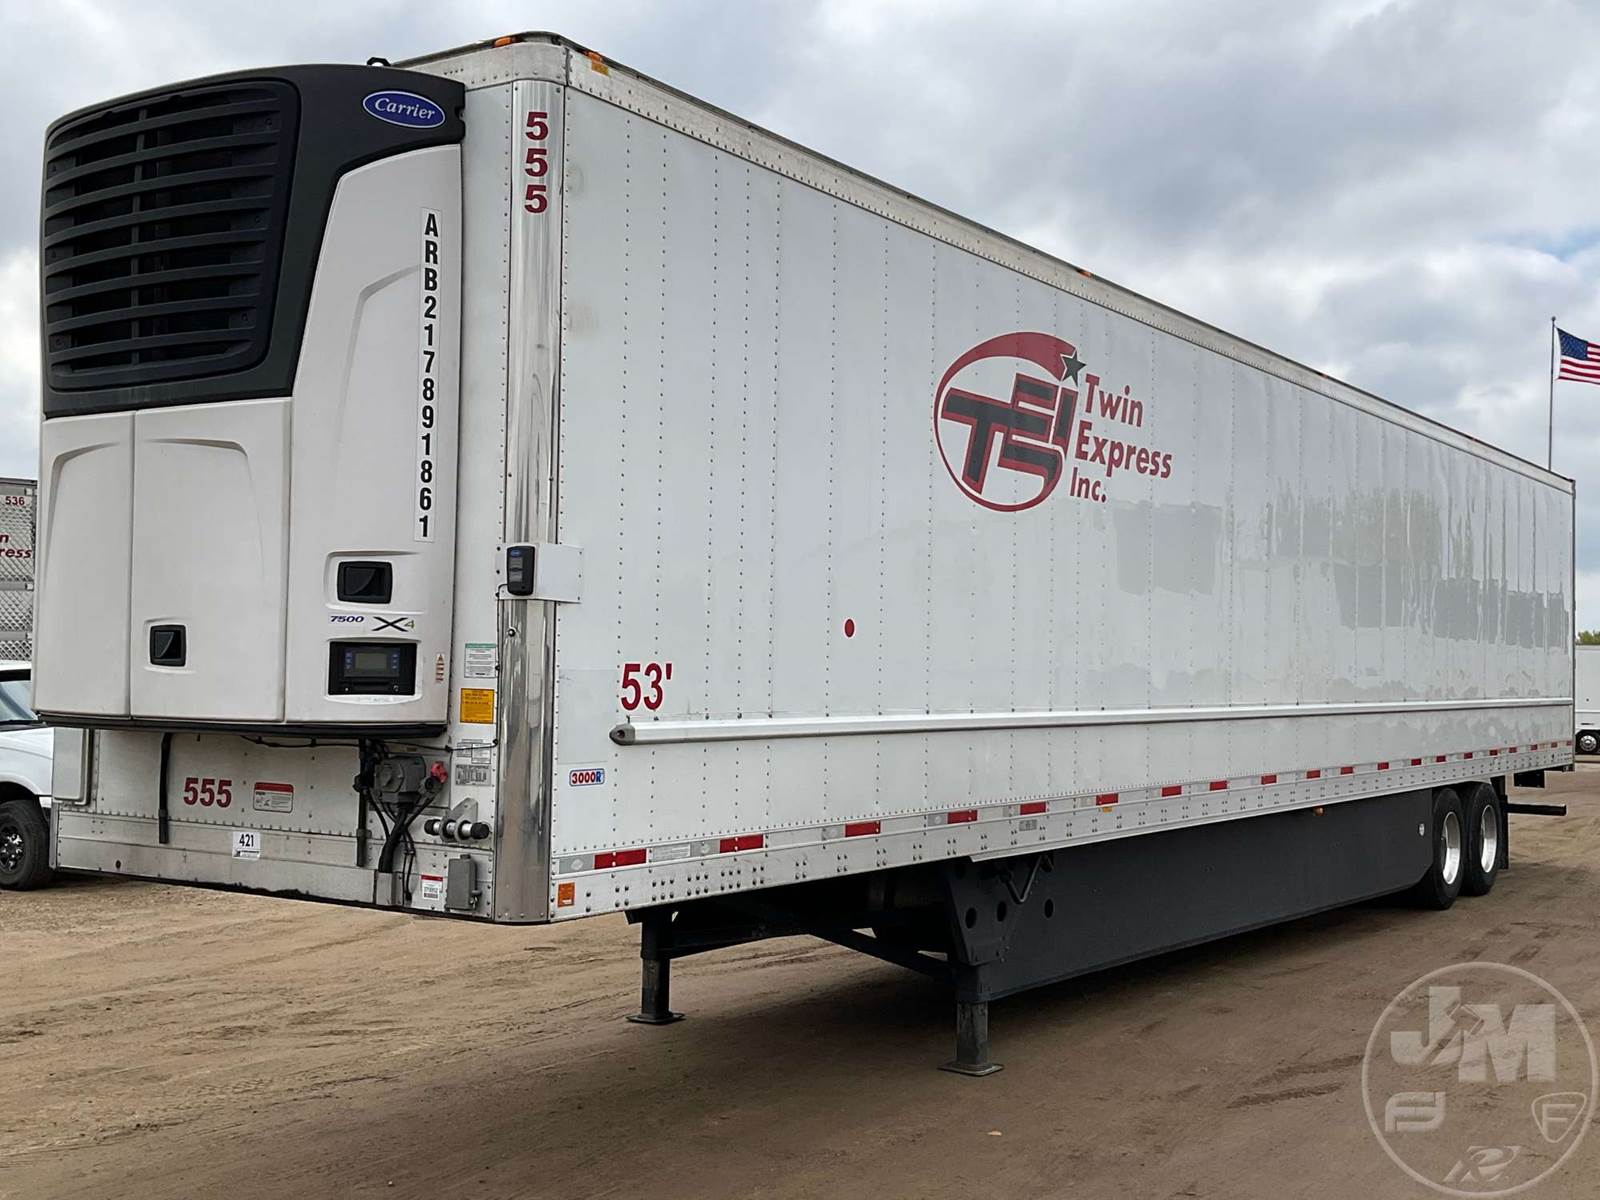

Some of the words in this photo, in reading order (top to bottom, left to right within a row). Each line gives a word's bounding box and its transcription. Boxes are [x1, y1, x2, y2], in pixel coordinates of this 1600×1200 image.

[374, 97, 436, 120] Carrier
[524, 111, 549, 214] 555
[419, 212, 439, 538] ARB217891861
[1085, 373, 1144, 427] Twin
[1074, 420, 1173, 479] Express
[5, 496, 25, 505] 536
[1069, 467, 1107, 503] Inc.
[330, 615, 365, 623] 7500
[620, 662, 672, 711] 53'
[183, 777, 232, 808] 555
[571, 771, 602, 784] 3000R
[239, 834, 254, 847] 421
